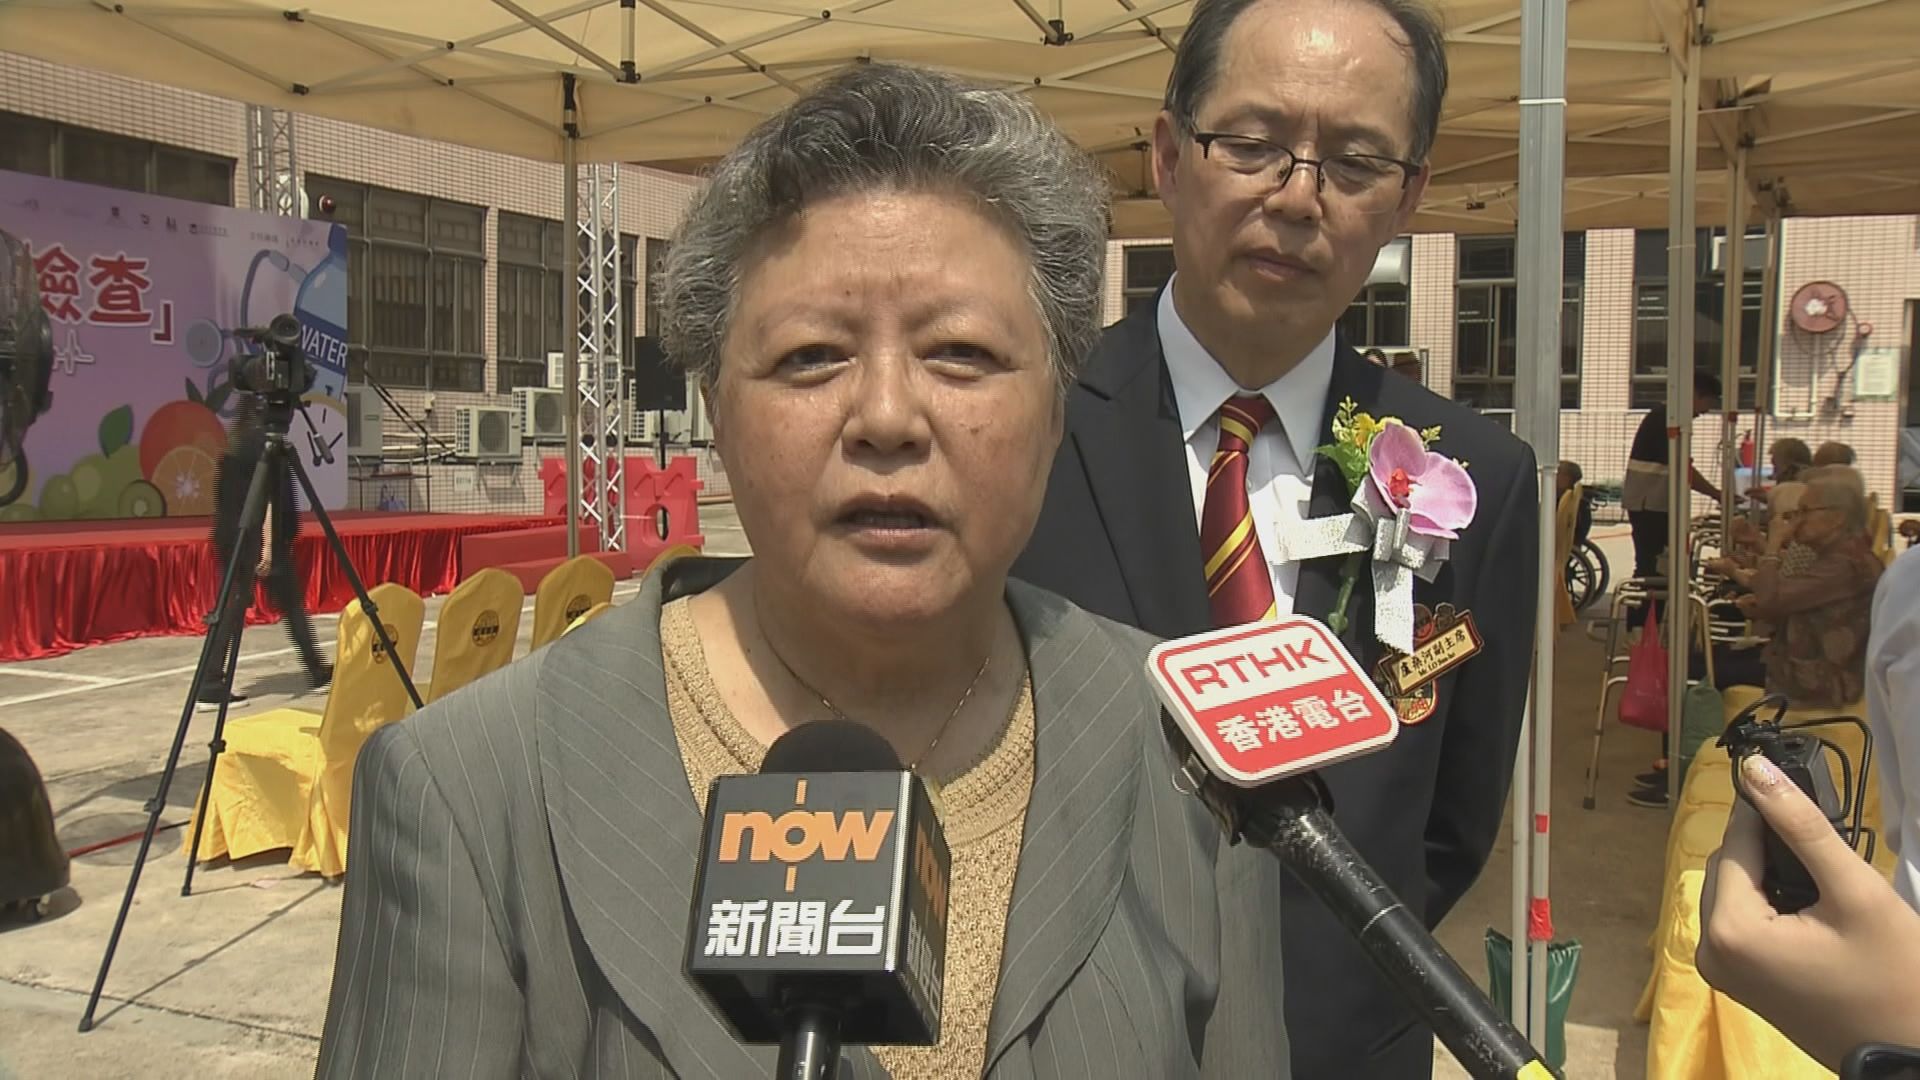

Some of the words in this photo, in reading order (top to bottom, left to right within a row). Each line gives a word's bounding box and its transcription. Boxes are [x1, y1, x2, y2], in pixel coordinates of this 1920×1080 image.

[1181, 638, 1329, 695] RTHK
[1216, 689, 1372, 753] 香港電台
[718, 810, 895, 863] now
[703, 899, 886, 957] 新聞台
